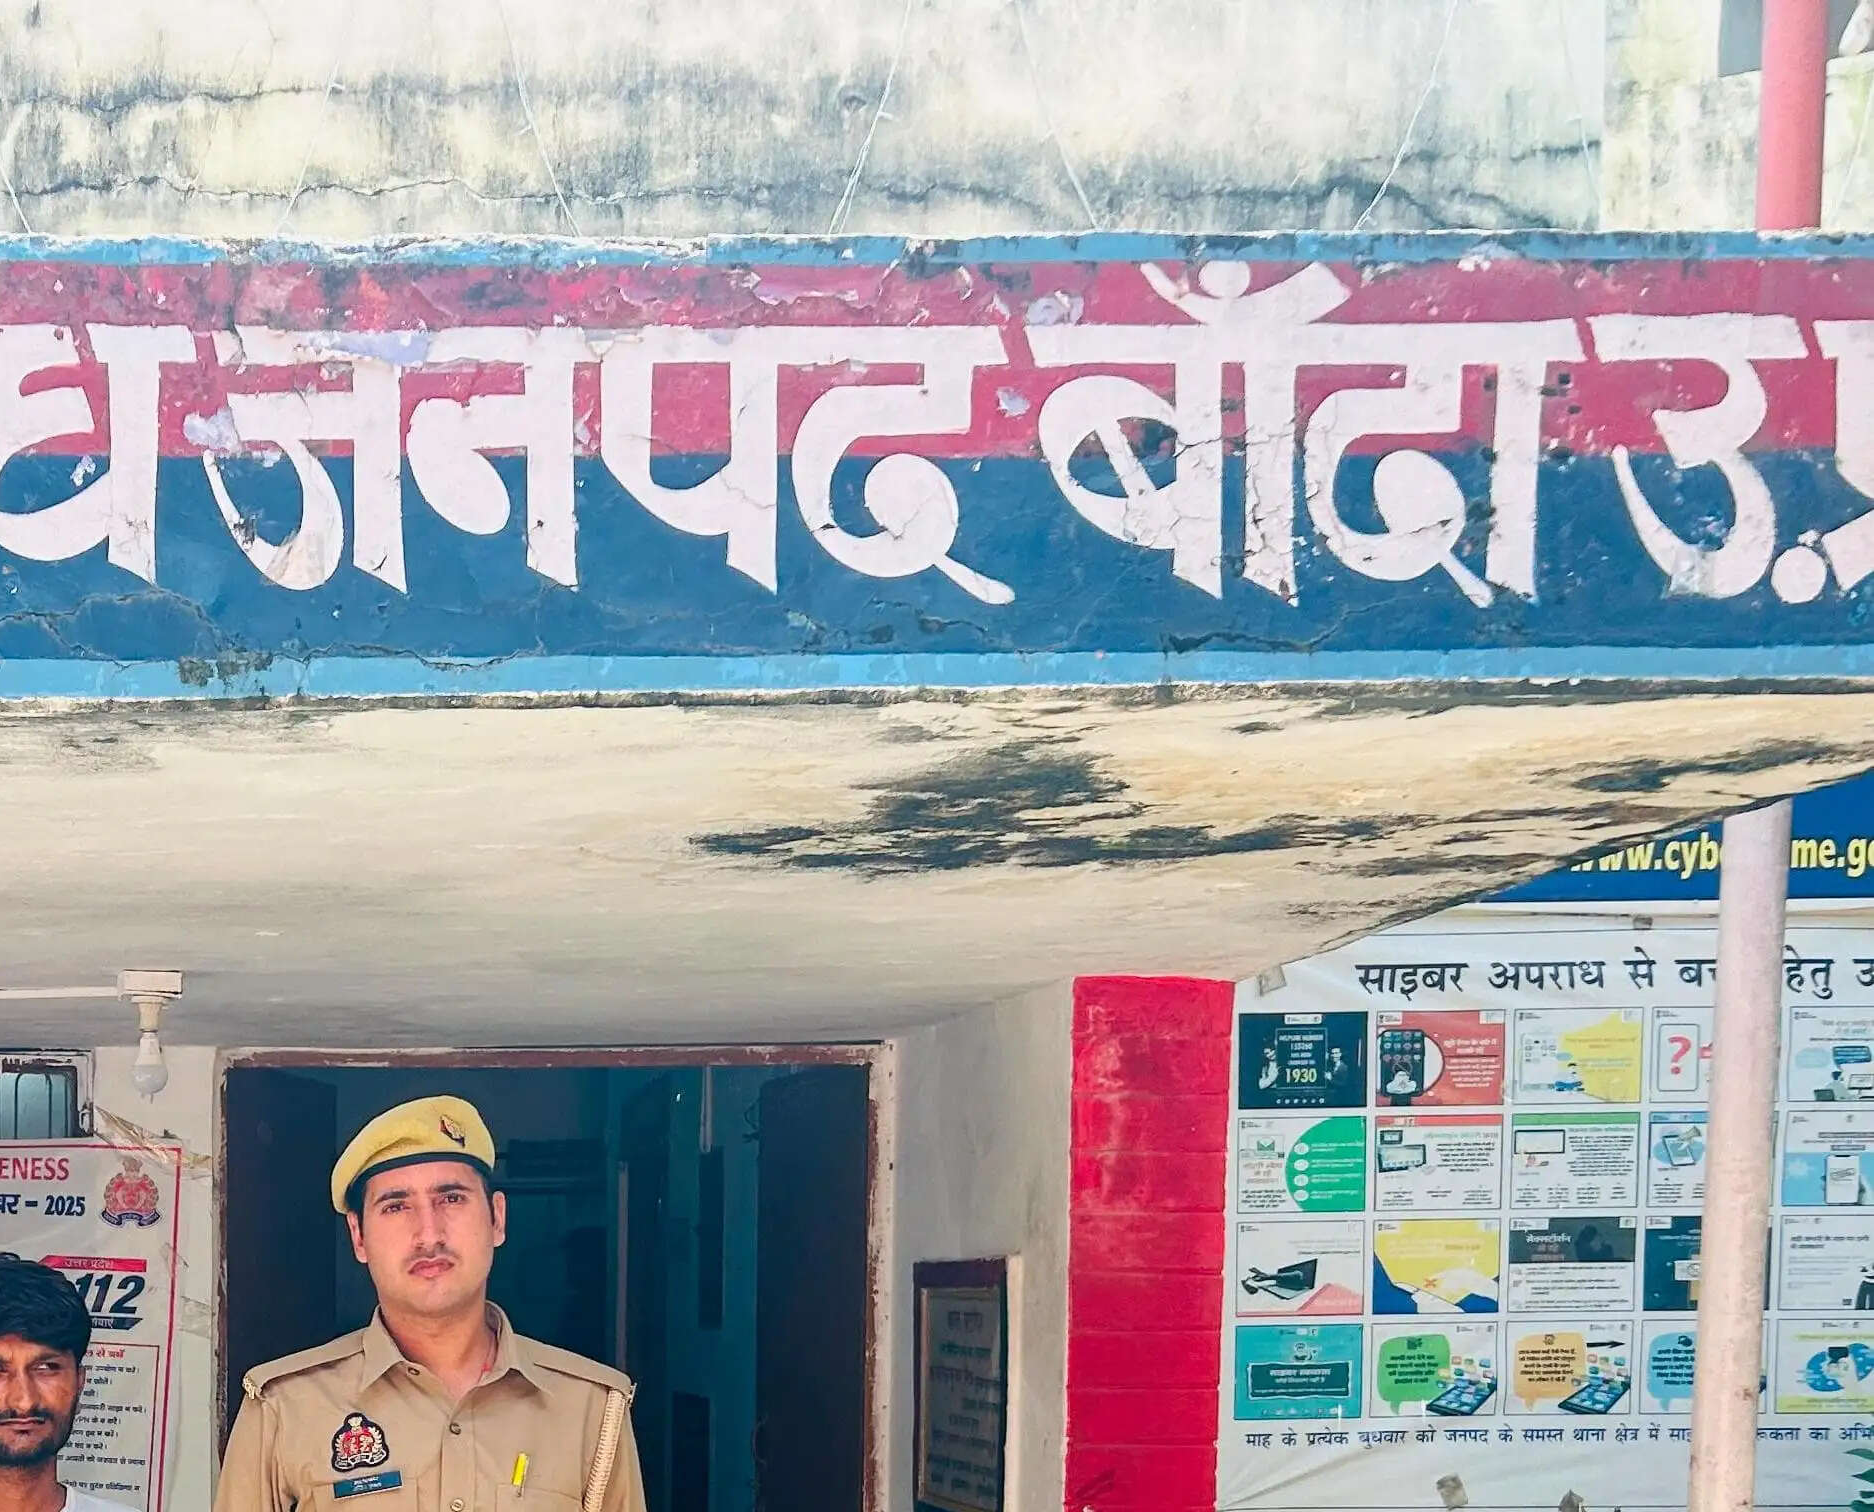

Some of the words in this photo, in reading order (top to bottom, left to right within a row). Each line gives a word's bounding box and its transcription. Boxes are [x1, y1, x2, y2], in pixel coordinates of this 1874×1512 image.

[203, 325, 1015, 604] जनपद
[1354, 962, 1469, 1001] साइबर
[1487, 960, 1606, 991] अपराध
[1622, 946, 1656, 990] से
[1285, 1068, 1318, 1084] 1930
[45, 1195, 86, 1217] 2025
[1245, 1432, 1273, 1449] माह
[1281, 1426, 1297, 1447] के
[1306, 1425, 1349, 1448] प्रत्येक
[1358, 1430, 1409, 1450] बुधवार
[1415, 1424, 1435, 1443] को
[1444, 1429, 1489, 1445] जनपद
[1498, 1423, 1513, 1443] के
[1522, 1427, 1563, 1443] समस्त
[1572, 1427, 1606, 1442] थाना
[1615, 1422, 1639, 1445] क्षेत्र
[1647, 1422, 1661, 1442] में
[1808, 1427, 1830, 1442] का
